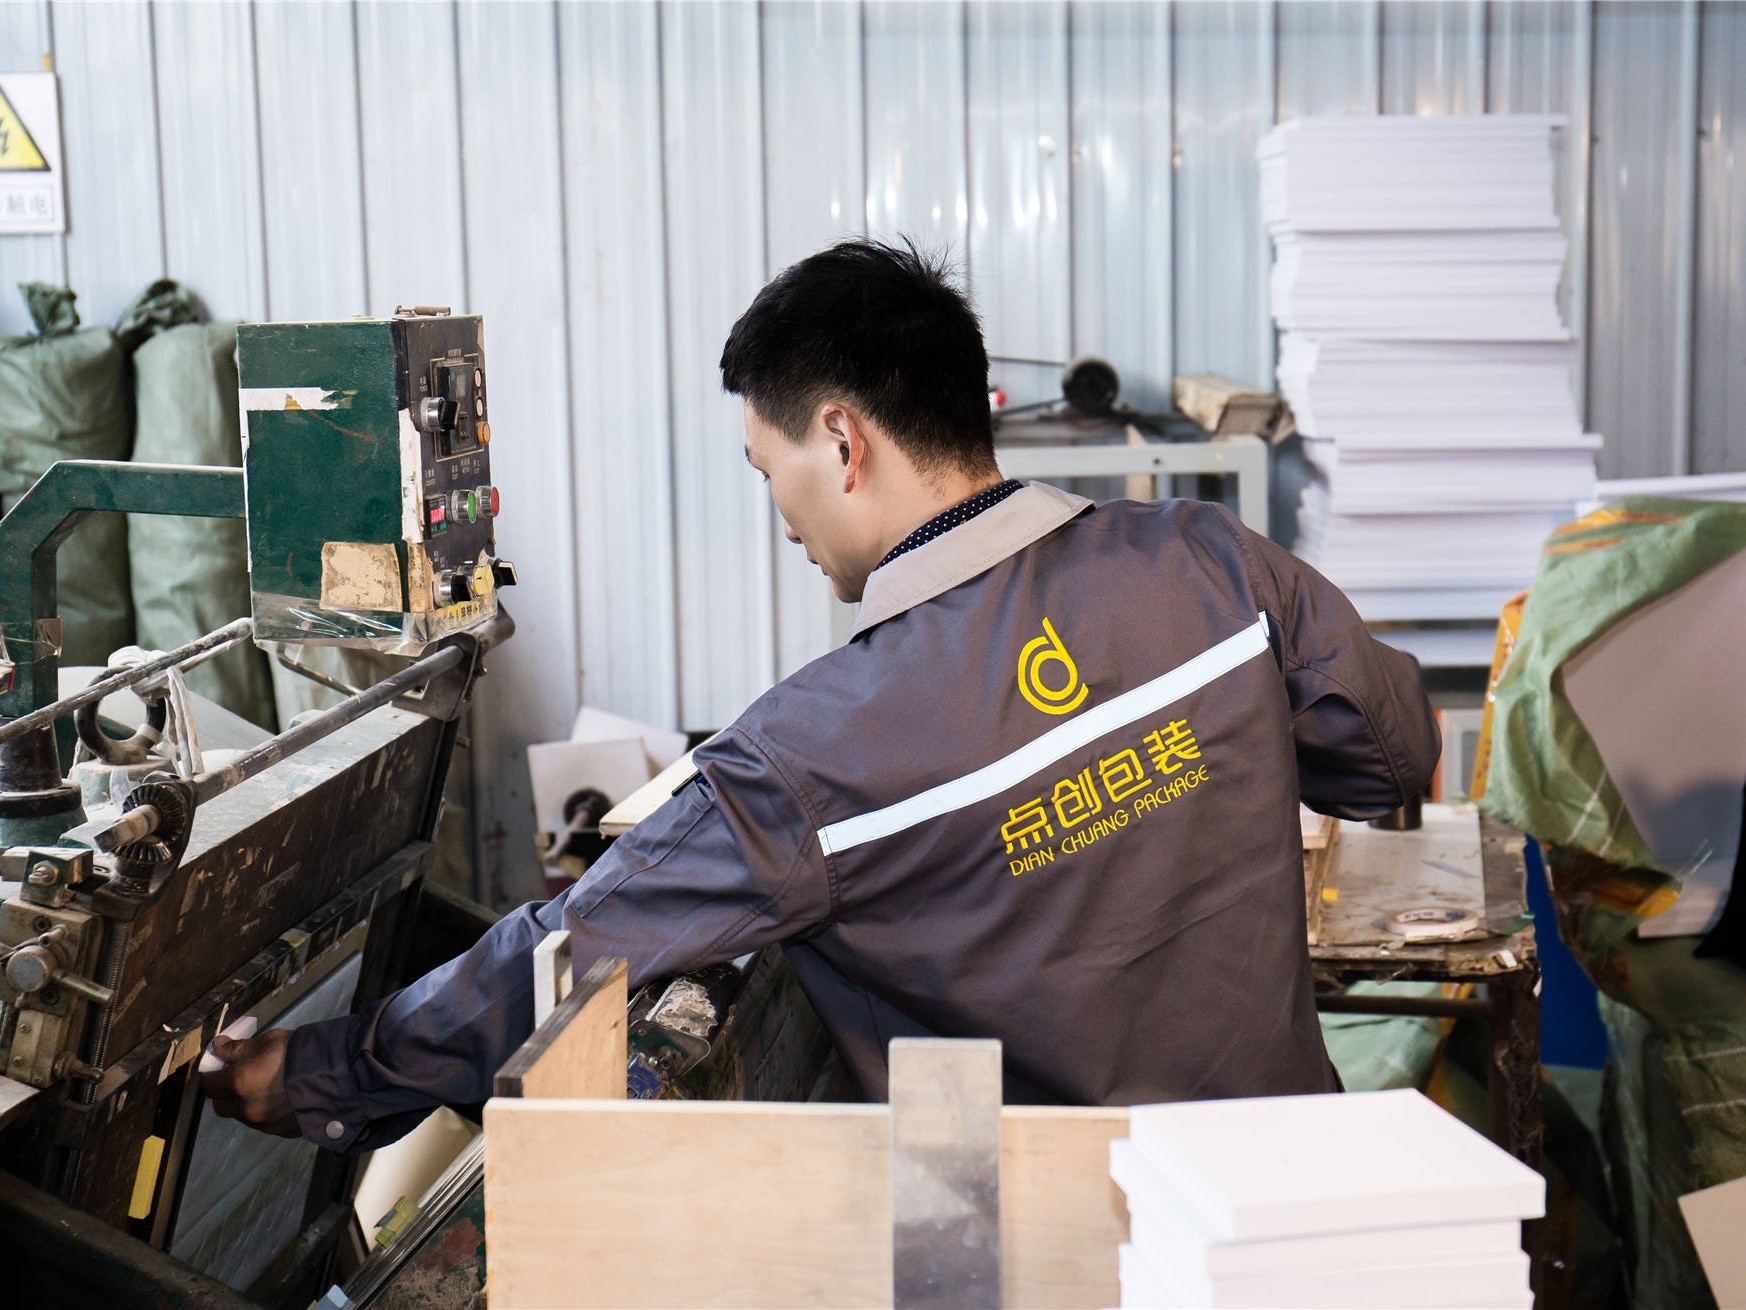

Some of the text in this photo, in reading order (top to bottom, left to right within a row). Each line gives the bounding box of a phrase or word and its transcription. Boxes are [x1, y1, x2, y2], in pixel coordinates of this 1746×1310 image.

[0, 193, 48, 217] 触电
[1001, 719, 1201, 854] 点创包装
[1009, 764, 1210, 877] DIAN CHUANG PACKAGE
